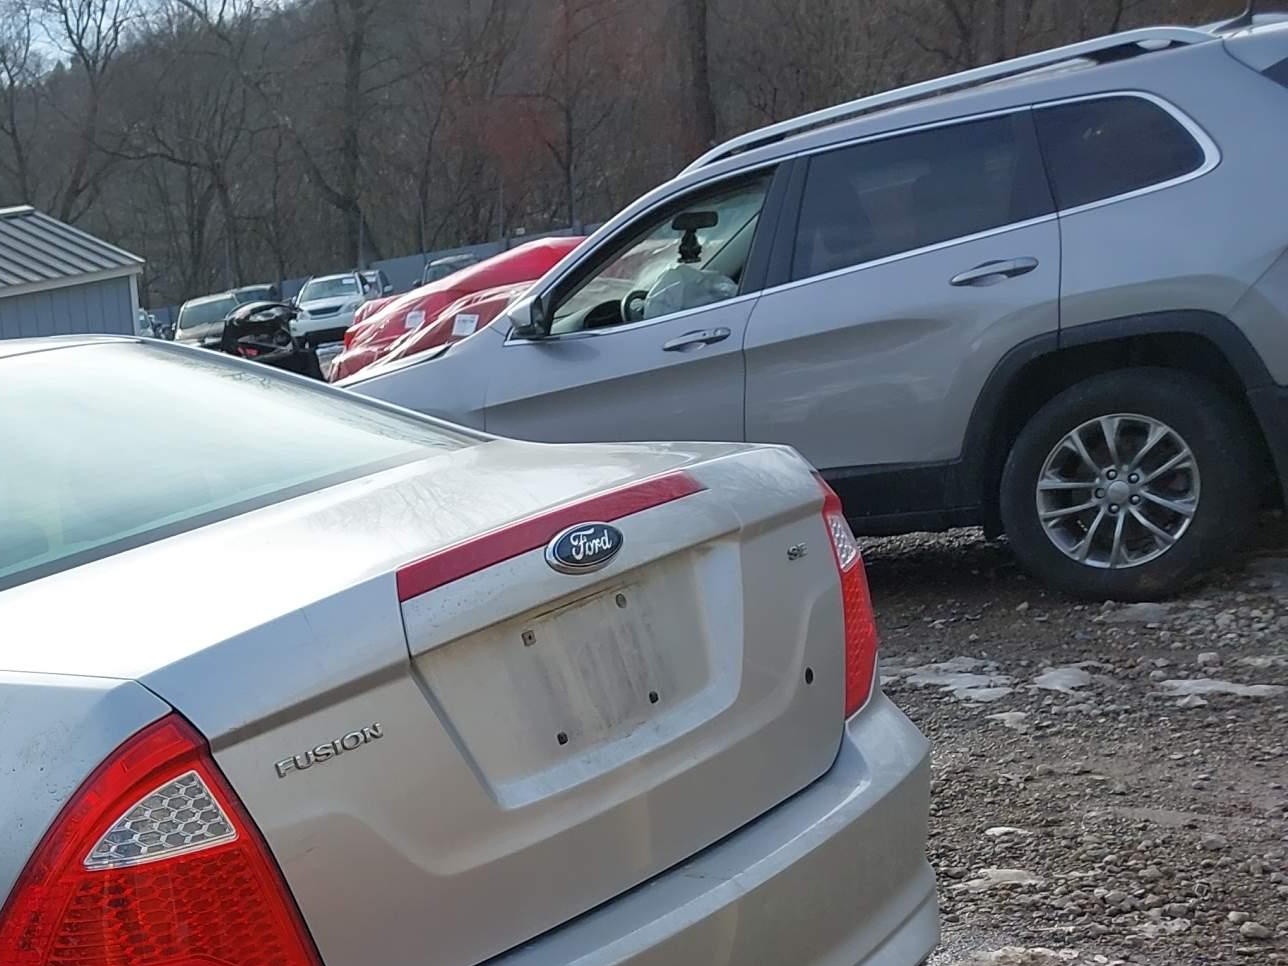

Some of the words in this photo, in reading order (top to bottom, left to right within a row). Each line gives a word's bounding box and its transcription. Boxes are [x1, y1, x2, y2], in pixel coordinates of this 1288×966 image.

[569, 527, 613, 561] Ford
[787, 542, 808, 561] SE
[274, 721, 384, 778] FUSION
